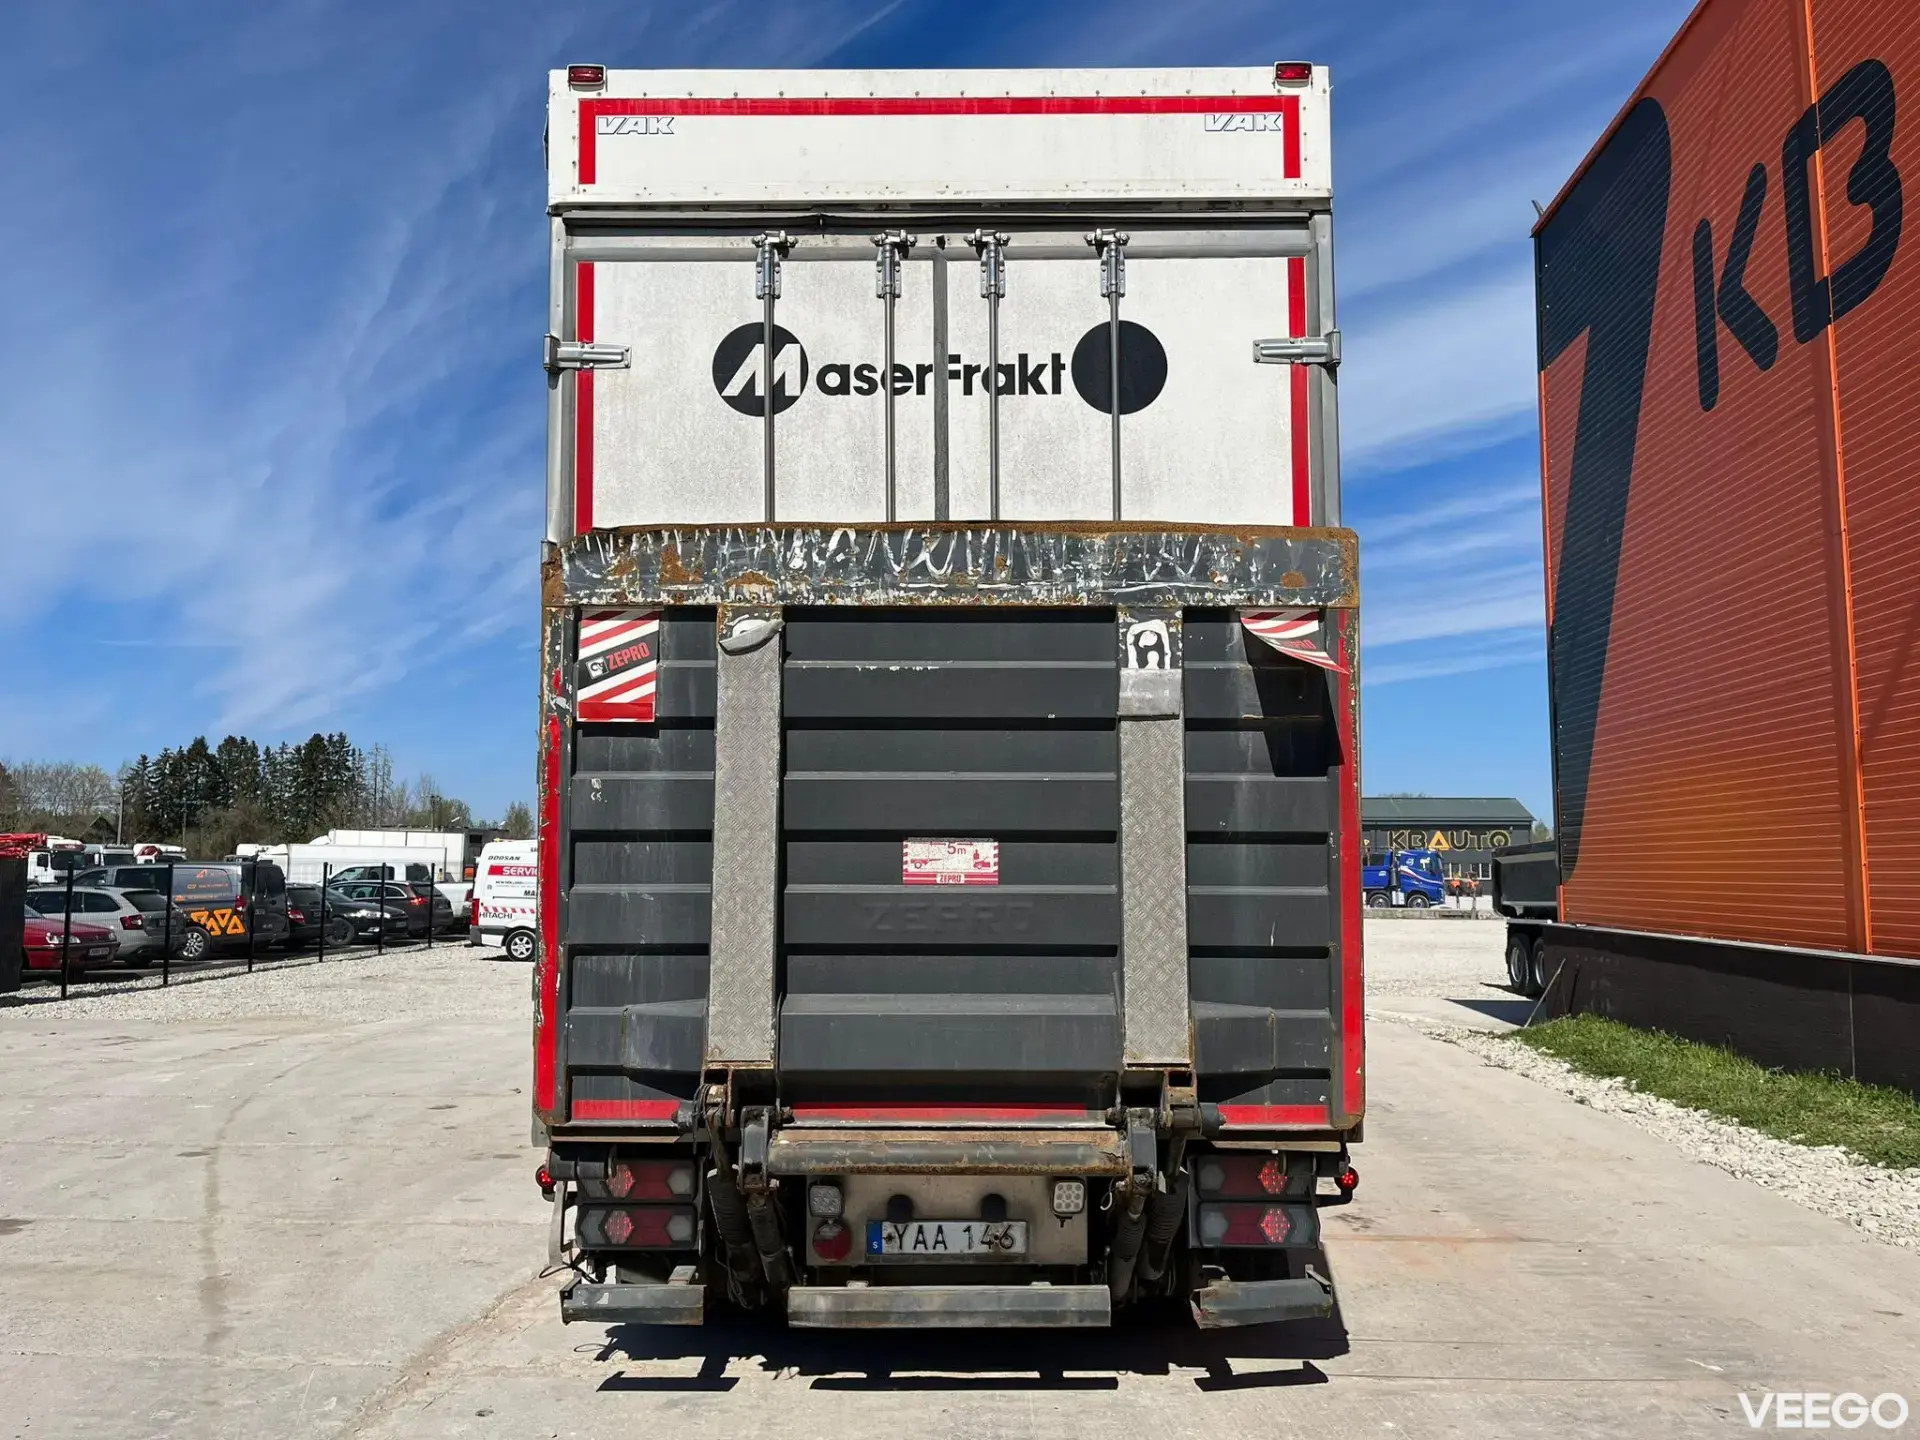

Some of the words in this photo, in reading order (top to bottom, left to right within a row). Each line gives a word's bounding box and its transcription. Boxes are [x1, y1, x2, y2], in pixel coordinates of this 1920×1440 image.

[597, 116, 675, 135] VAK
[1204, 113, 1282, 132] VAK
[606, 641, 651, 671] ZEPRO
[938, 874, 962, 884] ZEPRO
[479, 911, 513, 920] HITACHI
[893, 1223, 948, 1251] YAA
[963, 1223, 1015, 1250] 146
